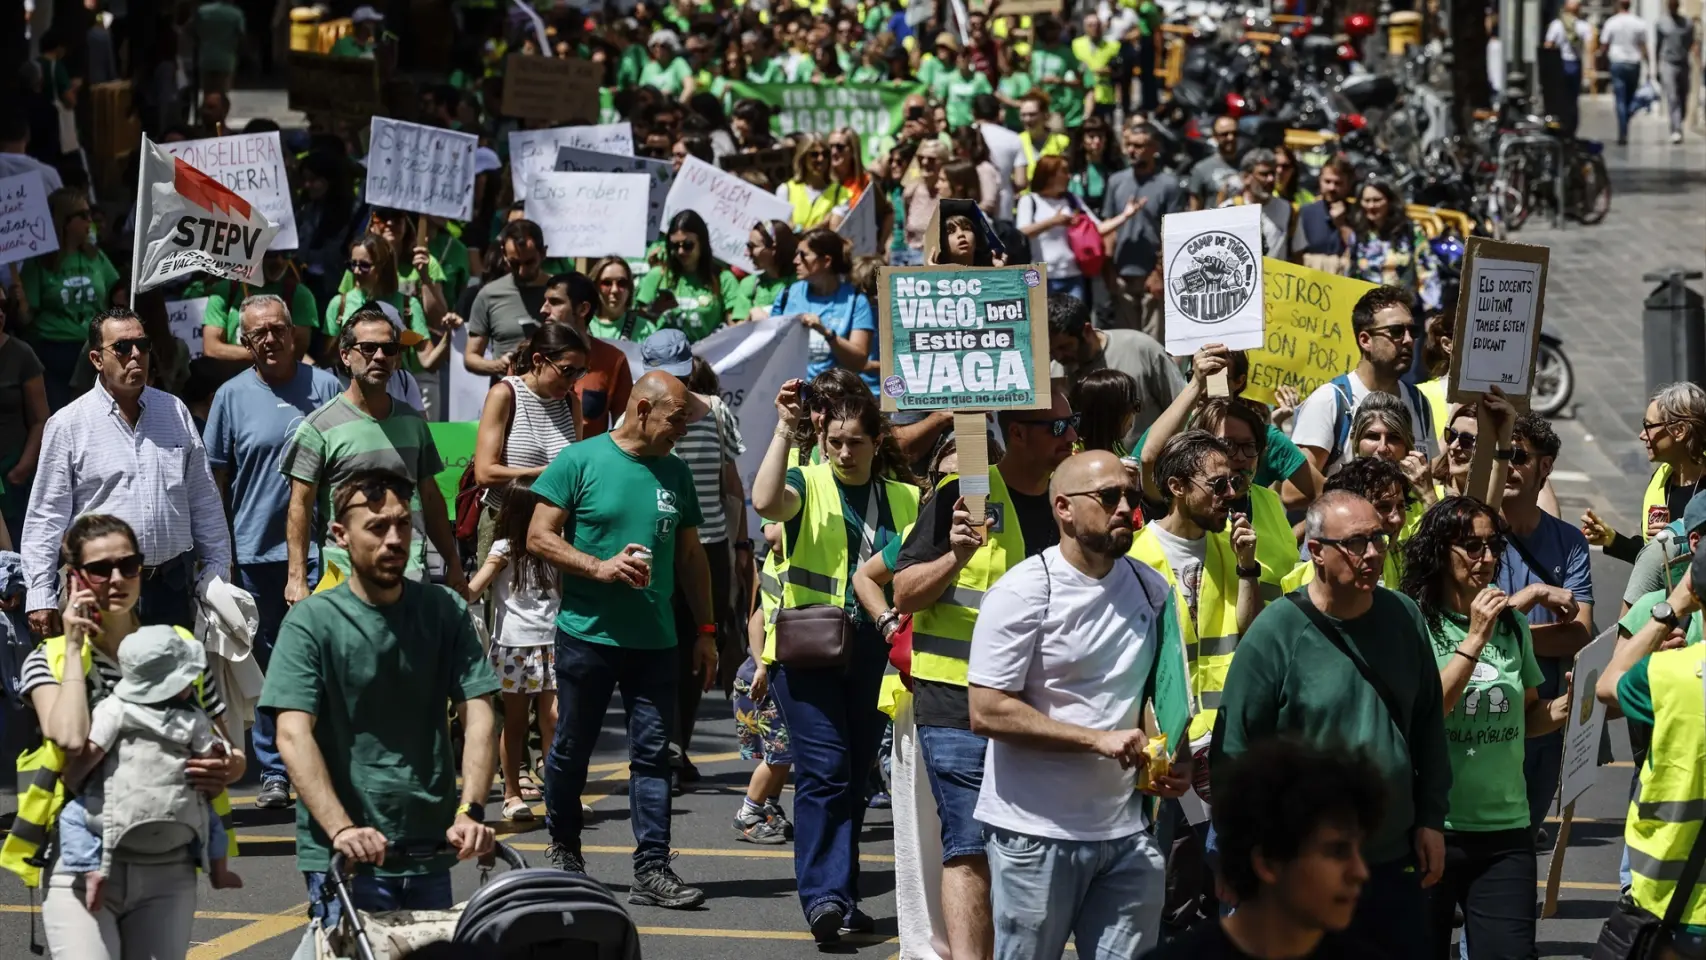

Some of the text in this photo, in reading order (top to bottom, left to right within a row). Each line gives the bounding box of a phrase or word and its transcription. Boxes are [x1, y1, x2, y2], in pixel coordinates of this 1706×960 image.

[169, 135, 279, 170] ONSELLERA
[171, 215, 263, 260] STEPV
[1186, 235, 1251, 266] CAMP DE TÚRIA
[896, 276, 982, 298] No soc
[1479, 276, 1533, 295] ELS DOCENTS
[897, 296, 1023, 330] VAGO, bro!
[1179, 294, 1199, 318] EN
[1200, 286, 1249, 321] LLUITA
[915, 330, 1011, 351] Estic de
[1290, 308, 1318, 335] SON
[1322, 316, 1343, 345] LA
[1475, 316, 1526, 333] TAMBÉ ESTEM
[1306, 339, 1339, 373] POR
[1472, 337, 1507, 351] EDUCANT
[897, 350, 1031, 395] VAGA
[902, 394, 949, 407] (Encara
[951, 395, 973, 408] que
[975, 393, 989, 405] no
